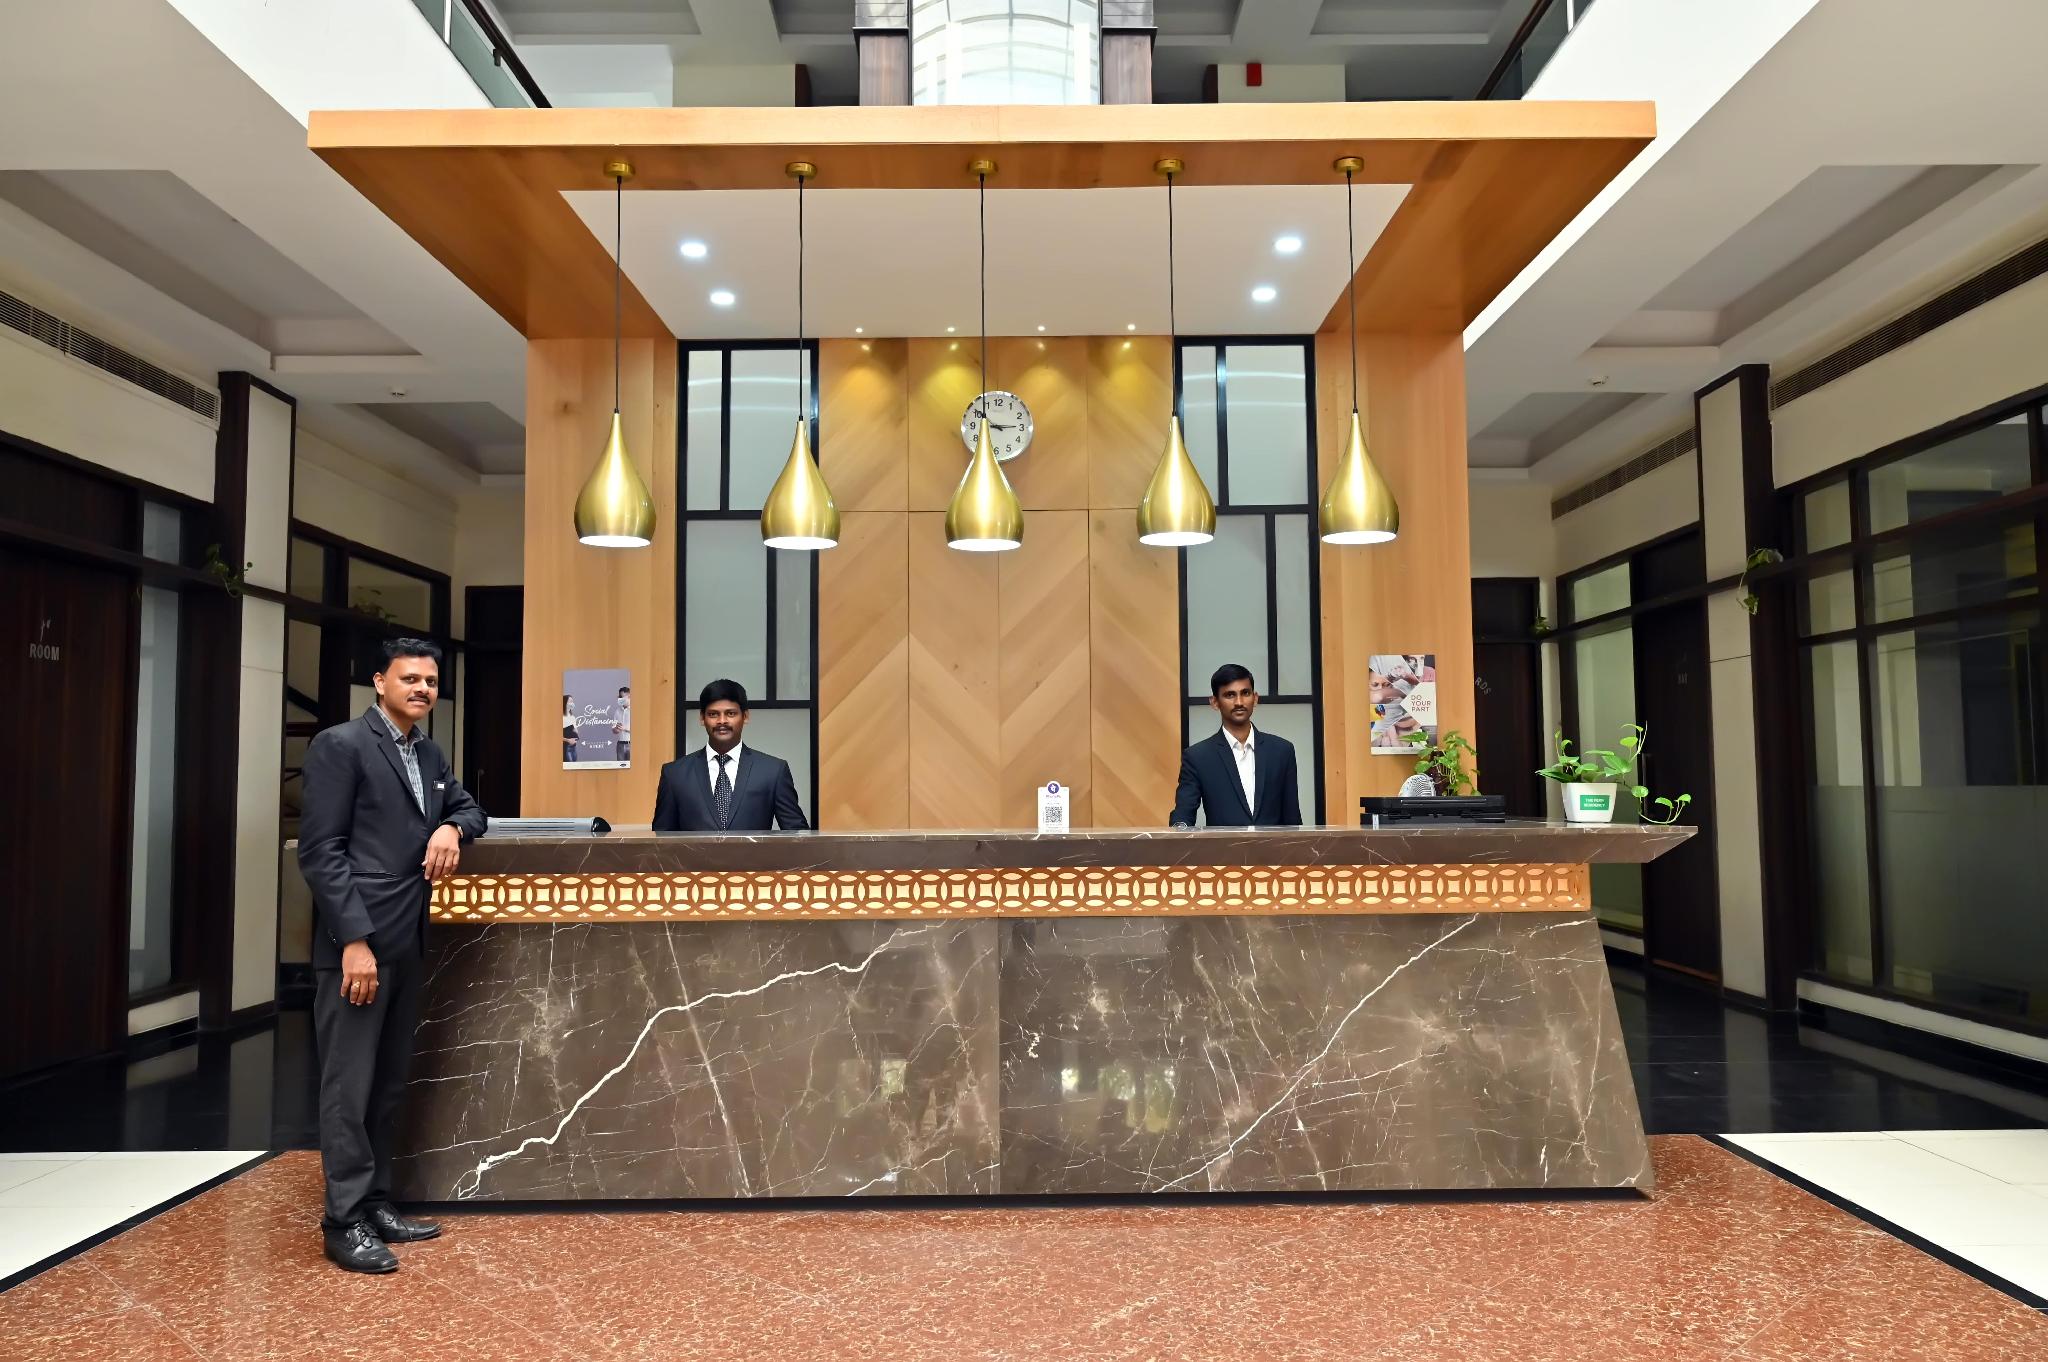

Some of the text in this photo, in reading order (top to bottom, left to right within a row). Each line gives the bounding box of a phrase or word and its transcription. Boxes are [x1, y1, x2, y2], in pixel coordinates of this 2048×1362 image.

[30, 643, 60, 660] ROOM
[584, 704, 610, 716] Social
[576, 716, 618, 728] Distancing
